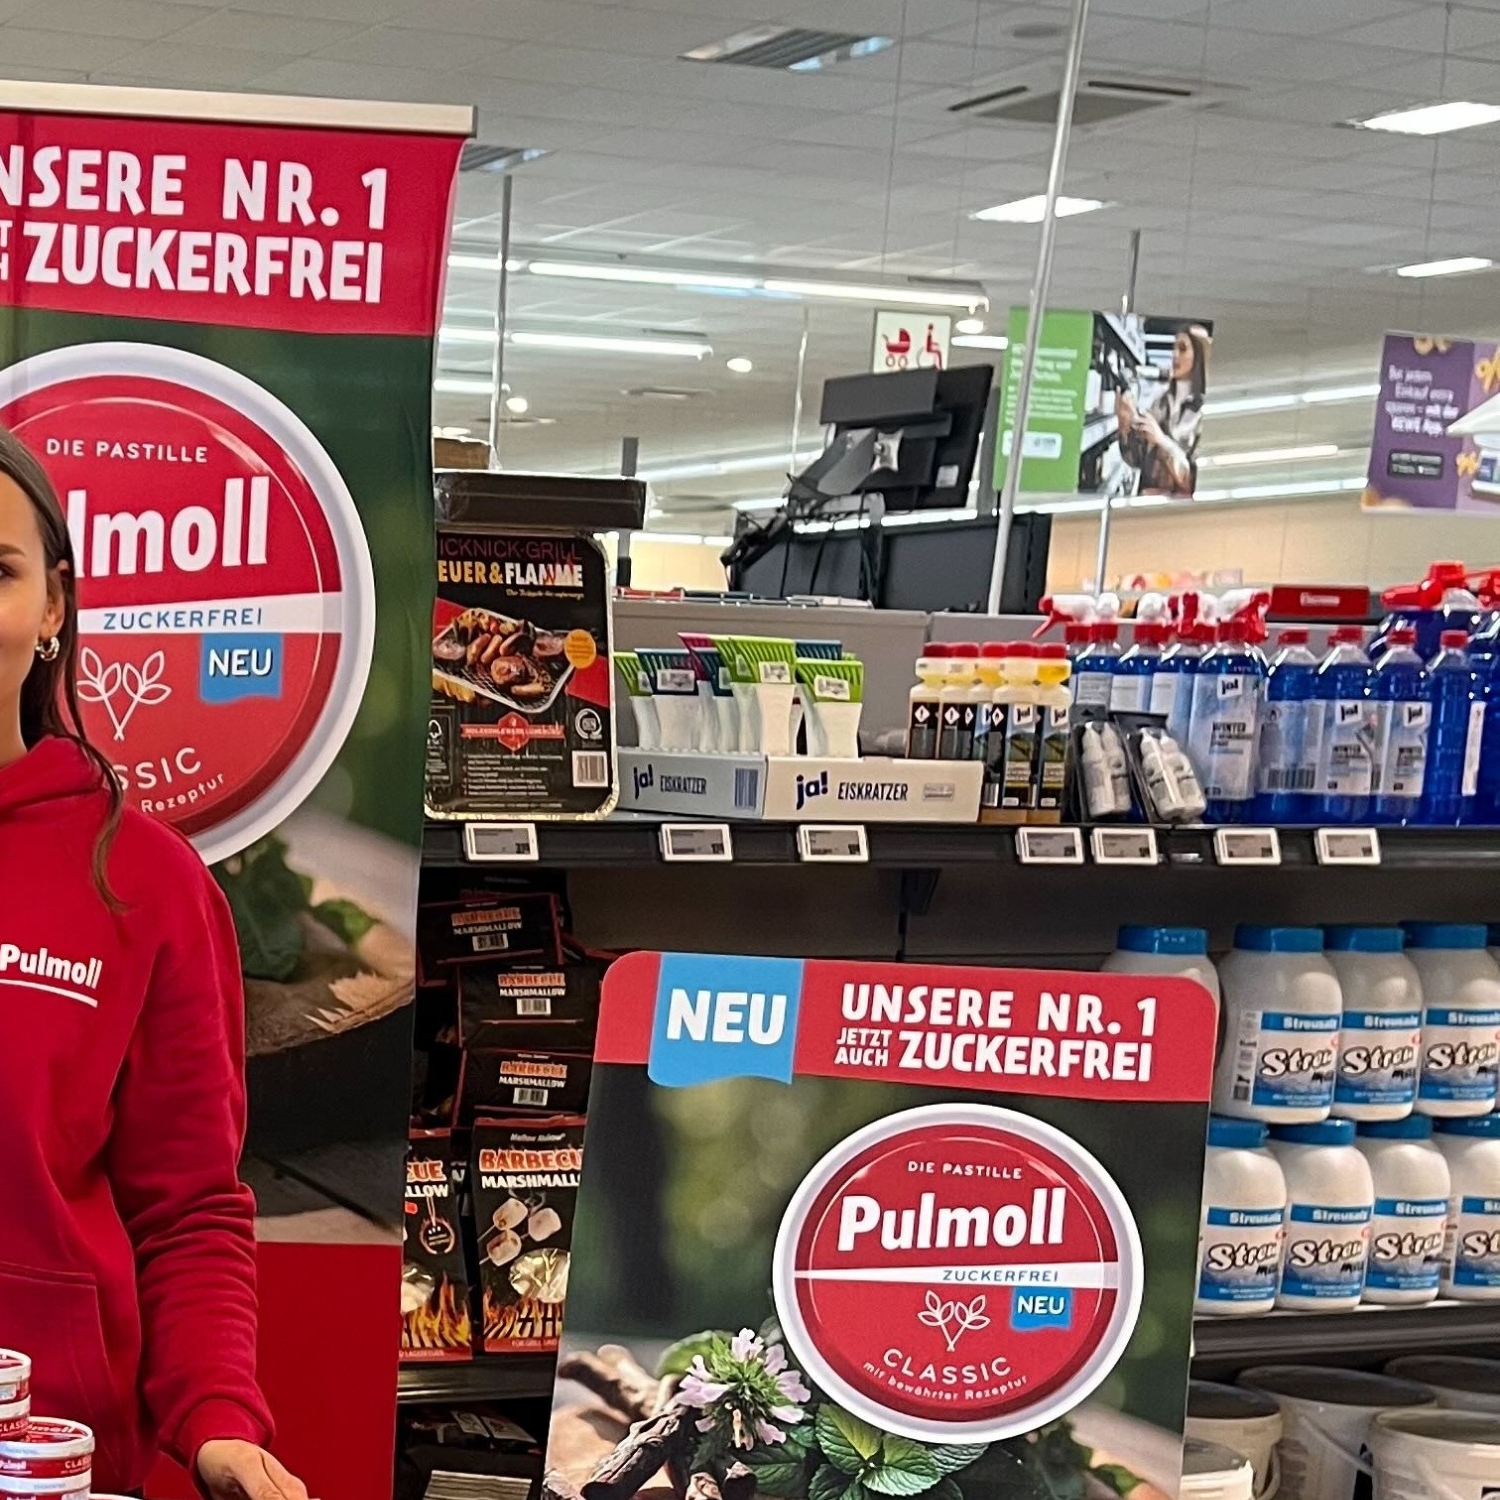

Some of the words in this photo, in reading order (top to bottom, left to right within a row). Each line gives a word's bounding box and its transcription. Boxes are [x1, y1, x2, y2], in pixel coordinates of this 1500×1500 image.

[222, 158, 339, 226] NR.
[362, 168, 389, 230] 1
[23, 220, 383, 304] ZUCKERFREI
[47, 438, 84, 457] DIE
[96, 440, 208, 464] PASTILLE
[67, 476, 270, 579] lmoll
[440, 538, 584, 561] ICKNICK-GRILL
[104, 608, 263, 631] ZUCKERFREI
[209, 649, 273, 677] NEU
[114, 747, 201, 789] SSIC
[634, 765, 653, 799] ja!
[661, 775, 707, 795] EISKRATZER
[141, 773, 225, 813] Rezeptur
[796, 771, 828, 810] ja!
[838, 782, 908, 801] EISKRATZER
[667, 989, 786, 1045] NEU
[841, 983, 1013, 1028] UNSERE
[1038, 993, 1121, 1035] NR.
[1139, 997, 1157, 1036] 1
[836, 1027, 891, 1048] JETZT
[834, 1046, 889, 1067] AUCH
[898, 1033, 1153, 1082] ZUCKERFREI
[479, 1148, 585, 1173] BARBECU
[908, 1161, 934, 1173] DIE
[943, 1163, 1022, 1180] PASTILLE
[481, 1173, 581, 1189] MARSHMALL
[838, 1188, 1066, 1251] Pulmoll
[943, 1270, 1058, 1282] ZUCKERFREI
[1018, 1296, 1065, 1315] NEU
[863, 1361, 884, 1380] mit
[888, 1375, 958, 1400] bewährter
[965, 1374, 1028, 1400] Rezeptur
[883, 1348, 1011, 1384] CLASSIC
